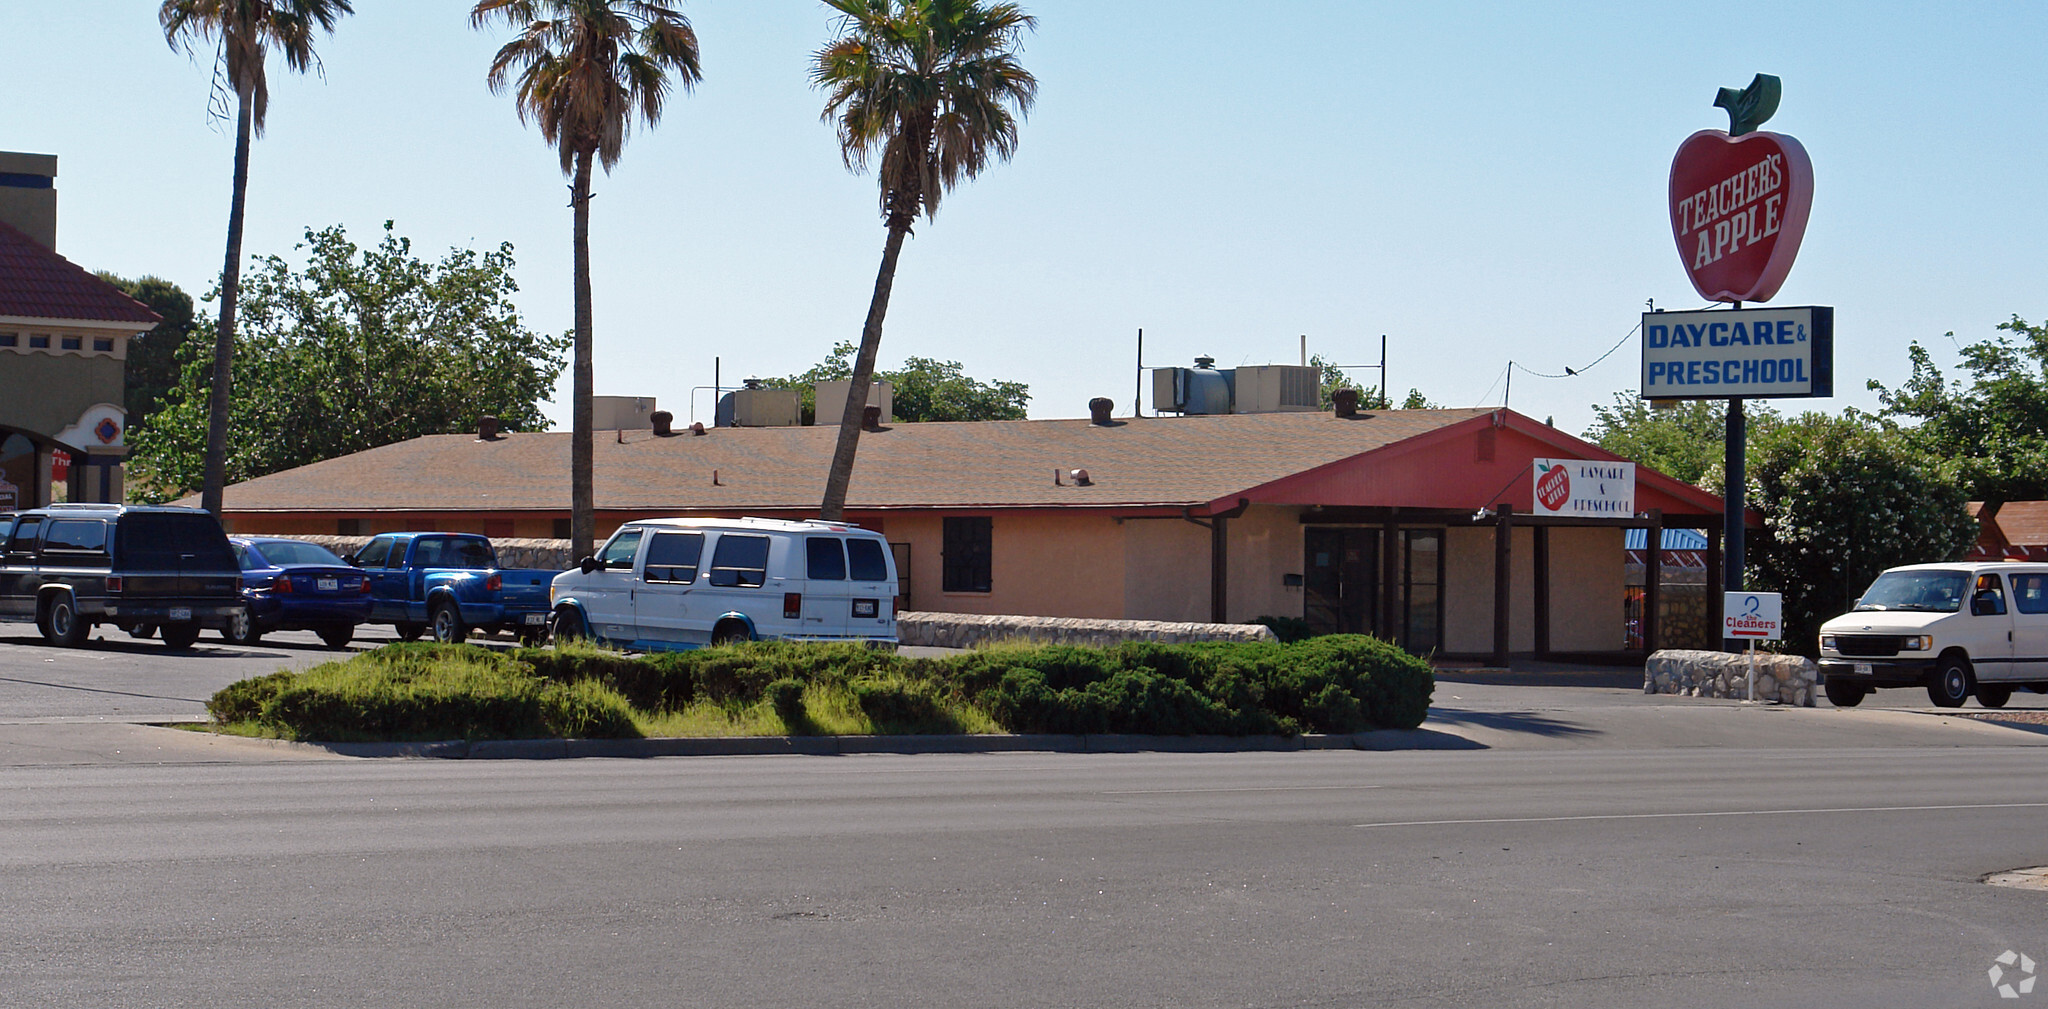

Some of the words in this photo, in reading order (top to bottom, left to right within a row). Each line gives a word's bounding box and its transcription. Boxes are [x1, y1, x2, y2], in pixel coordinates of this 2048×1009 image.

[1678, 153, 1782, 236] TEACHER'S
[1693, 193, 1781, 271] APPLE
[1649, 321, 1795, 348] DAYCARE
[1797, 324, 1806, 342] &
[1648, 359, 1808, 386] PRESCHOOL
[1580, 467, 1625, 479] DAYCARE
[1546, 484, 1566, 506] APPLE
[1599, 483, 1605, 495] &
[1573, 499, 1631, 512] PRESCHOOL
[1726, 616, 1776, 629] Cleaners
